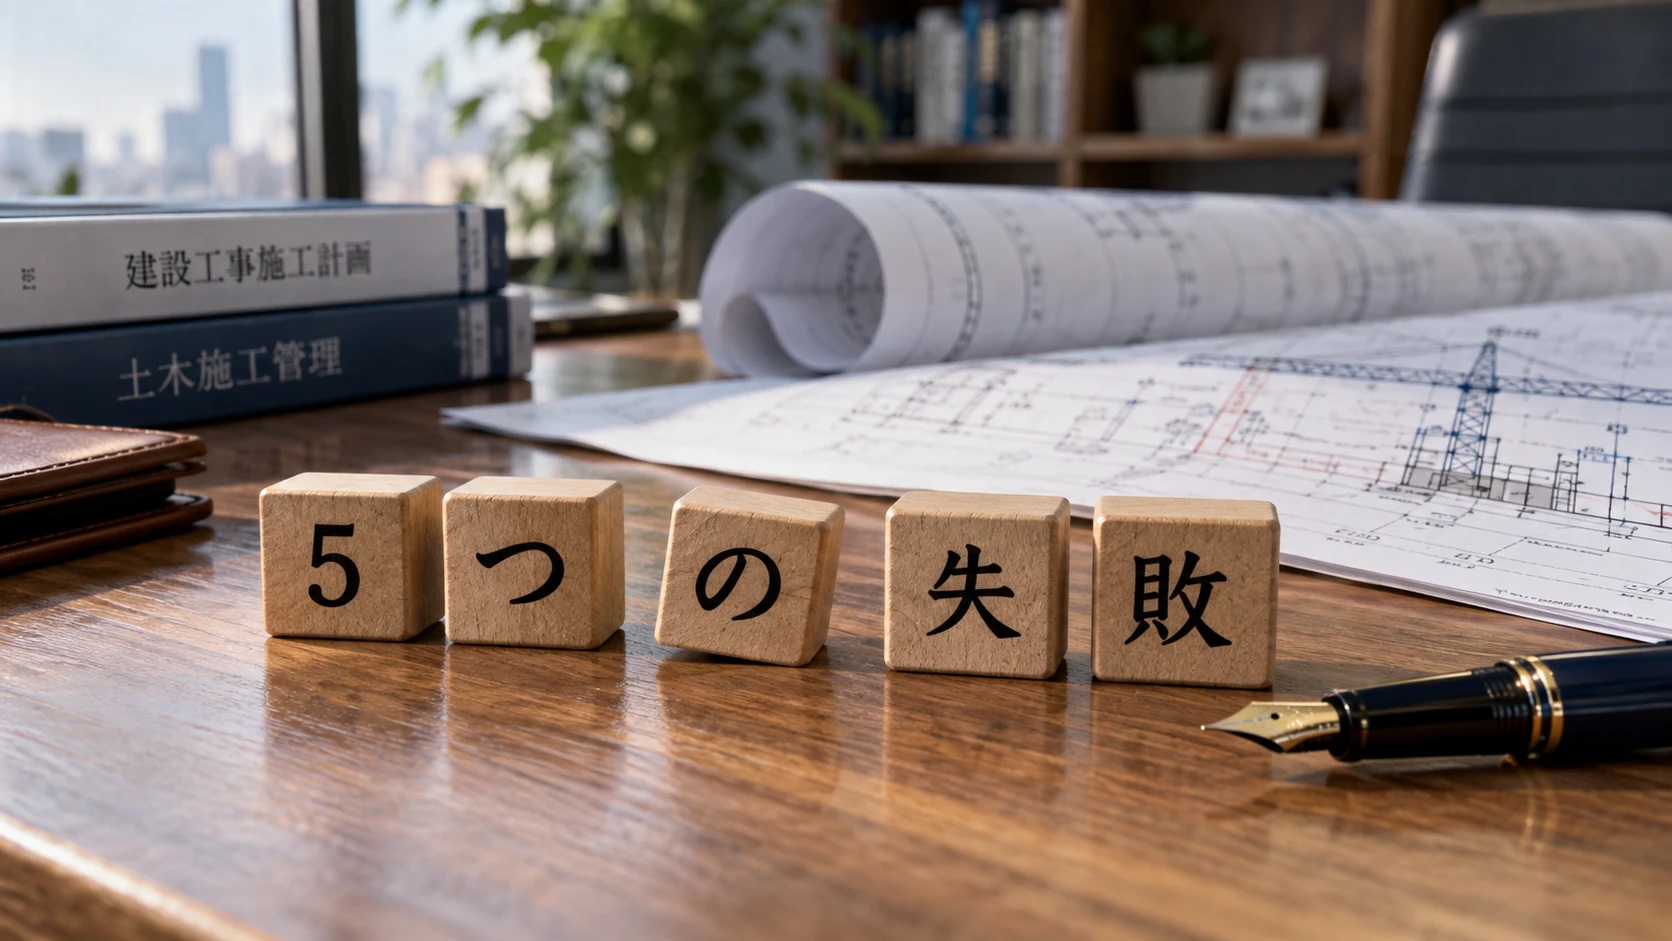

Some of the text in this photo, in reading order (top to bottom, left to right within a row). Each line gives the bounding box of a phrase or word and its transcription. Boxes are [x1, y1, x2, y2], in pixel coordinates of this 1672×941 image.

[125, 241, 371, 290] 建設工事施工計画
[118, 337, 342, 400] 土木施工管理
[308, 523, 1232, 648] 5つの失敗
